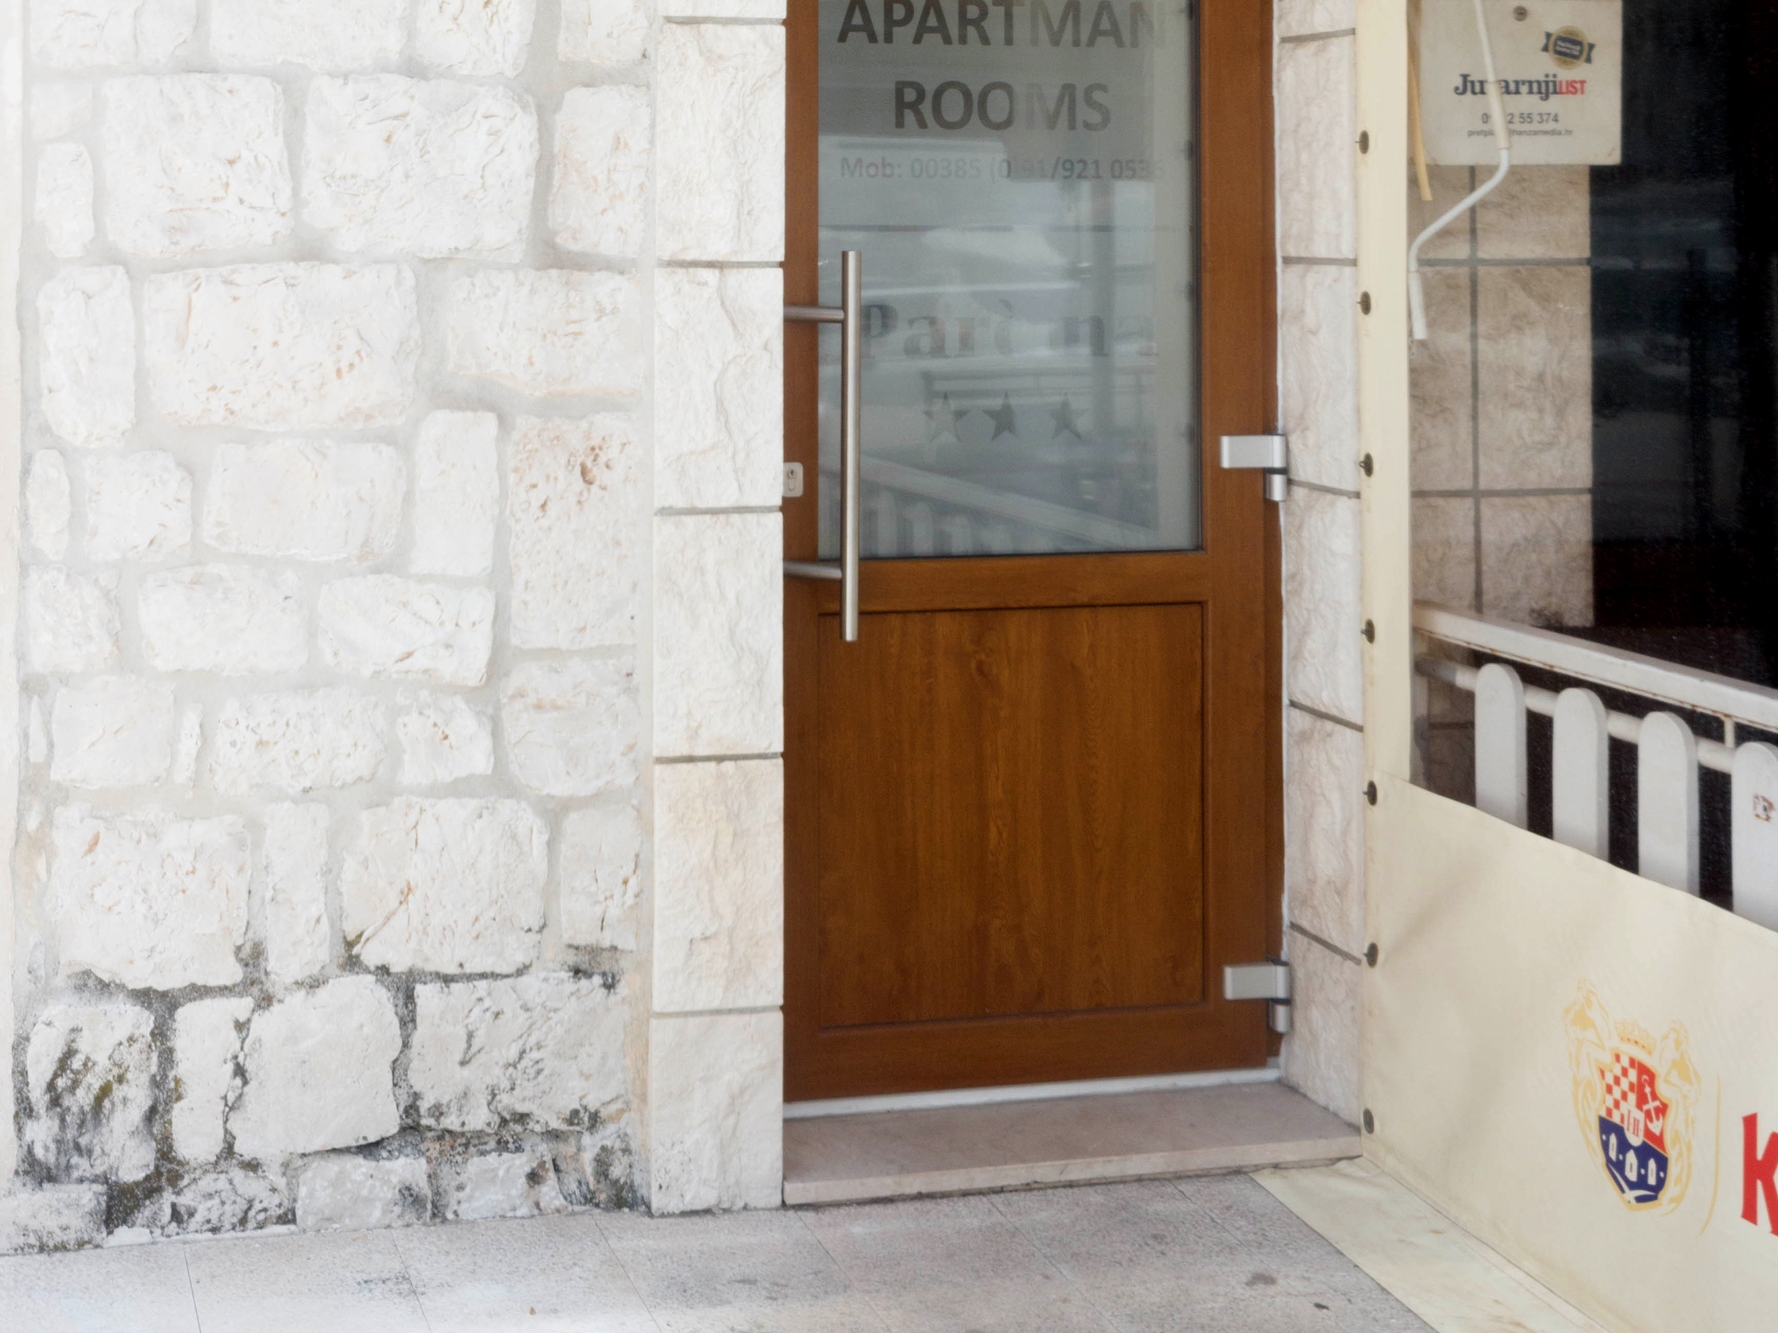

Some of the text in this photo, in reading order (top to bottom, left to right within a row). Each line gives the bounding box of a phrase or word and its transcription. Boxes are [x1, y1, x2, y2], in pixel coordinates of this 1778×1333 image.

[894, 80, 1111, 132] ROOMS
[841, 156, 902, 179] Mob:
[910, 157, 982, 180] 00385
